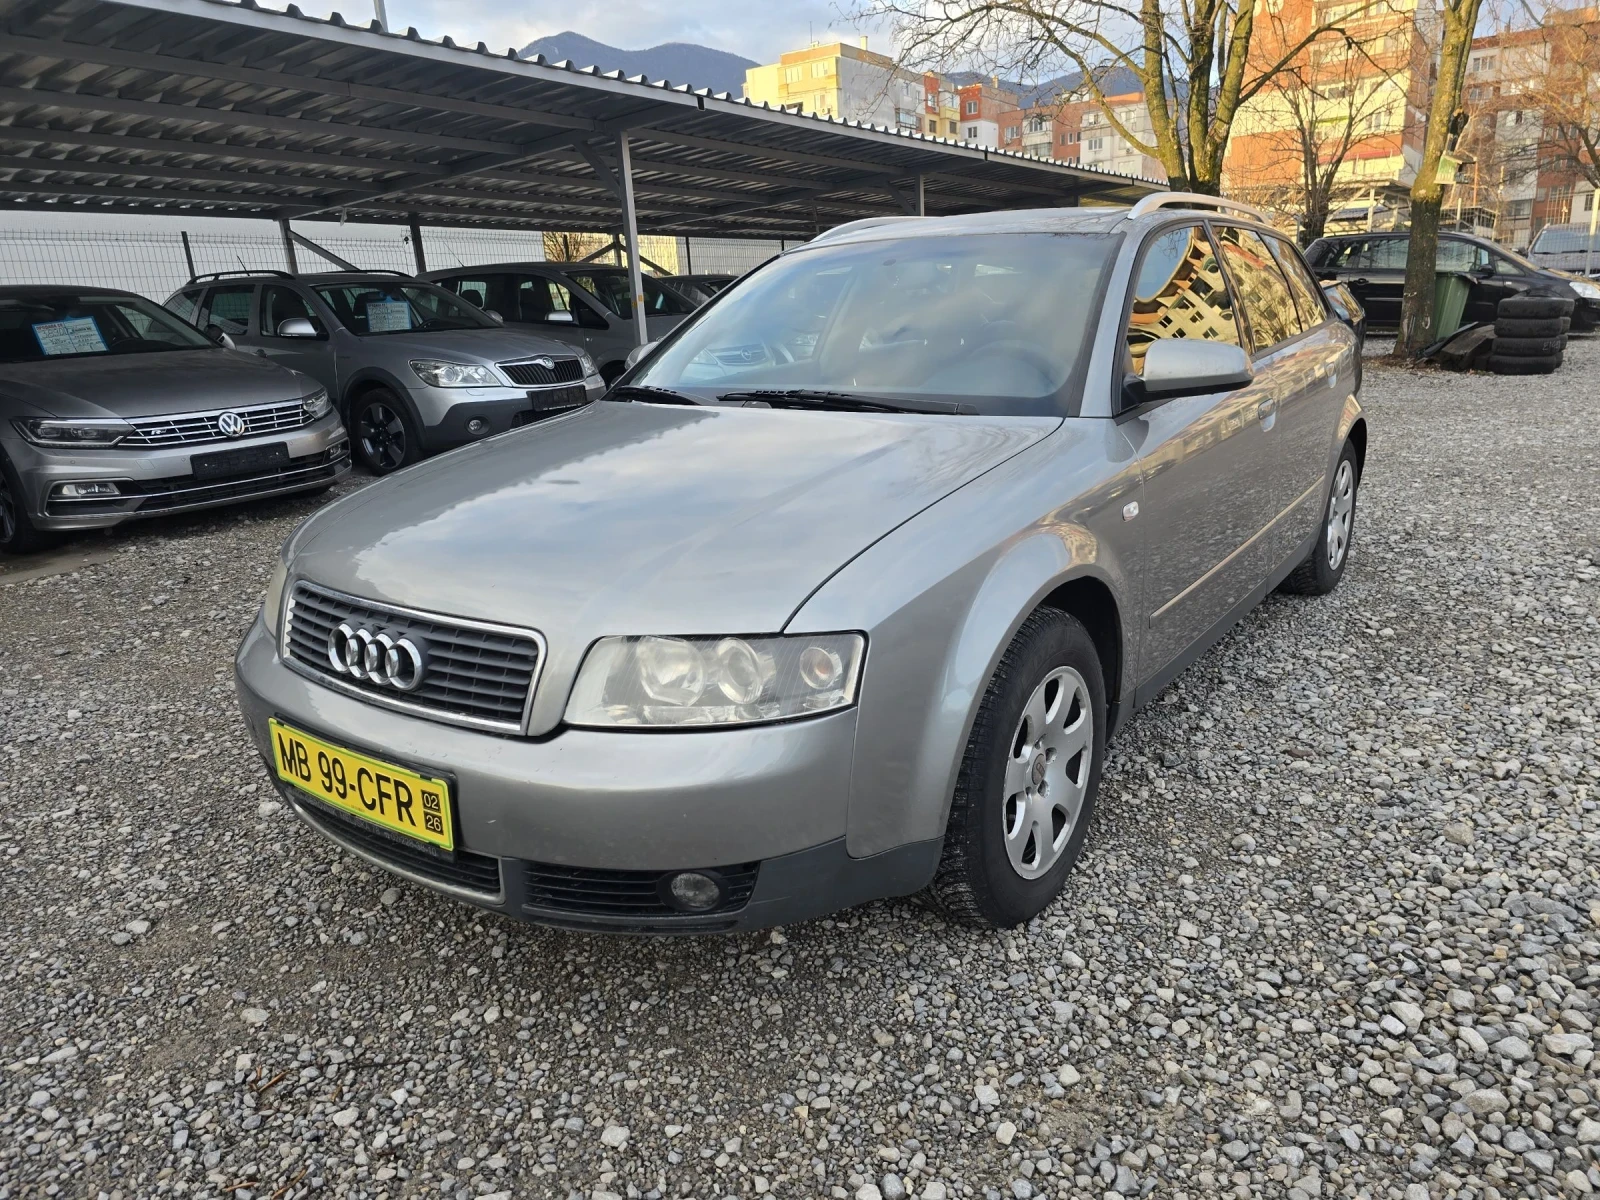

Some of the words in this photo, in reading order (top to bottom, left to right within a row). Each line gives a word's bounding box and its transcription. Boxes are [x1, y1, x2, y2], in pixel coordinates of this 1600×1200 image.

[278, 733, 311, 782] MB
[318, 751, 417, 827] 99-CFR
[423, 793, 439, 810] 02
[426, 815, 442, 832] 26
